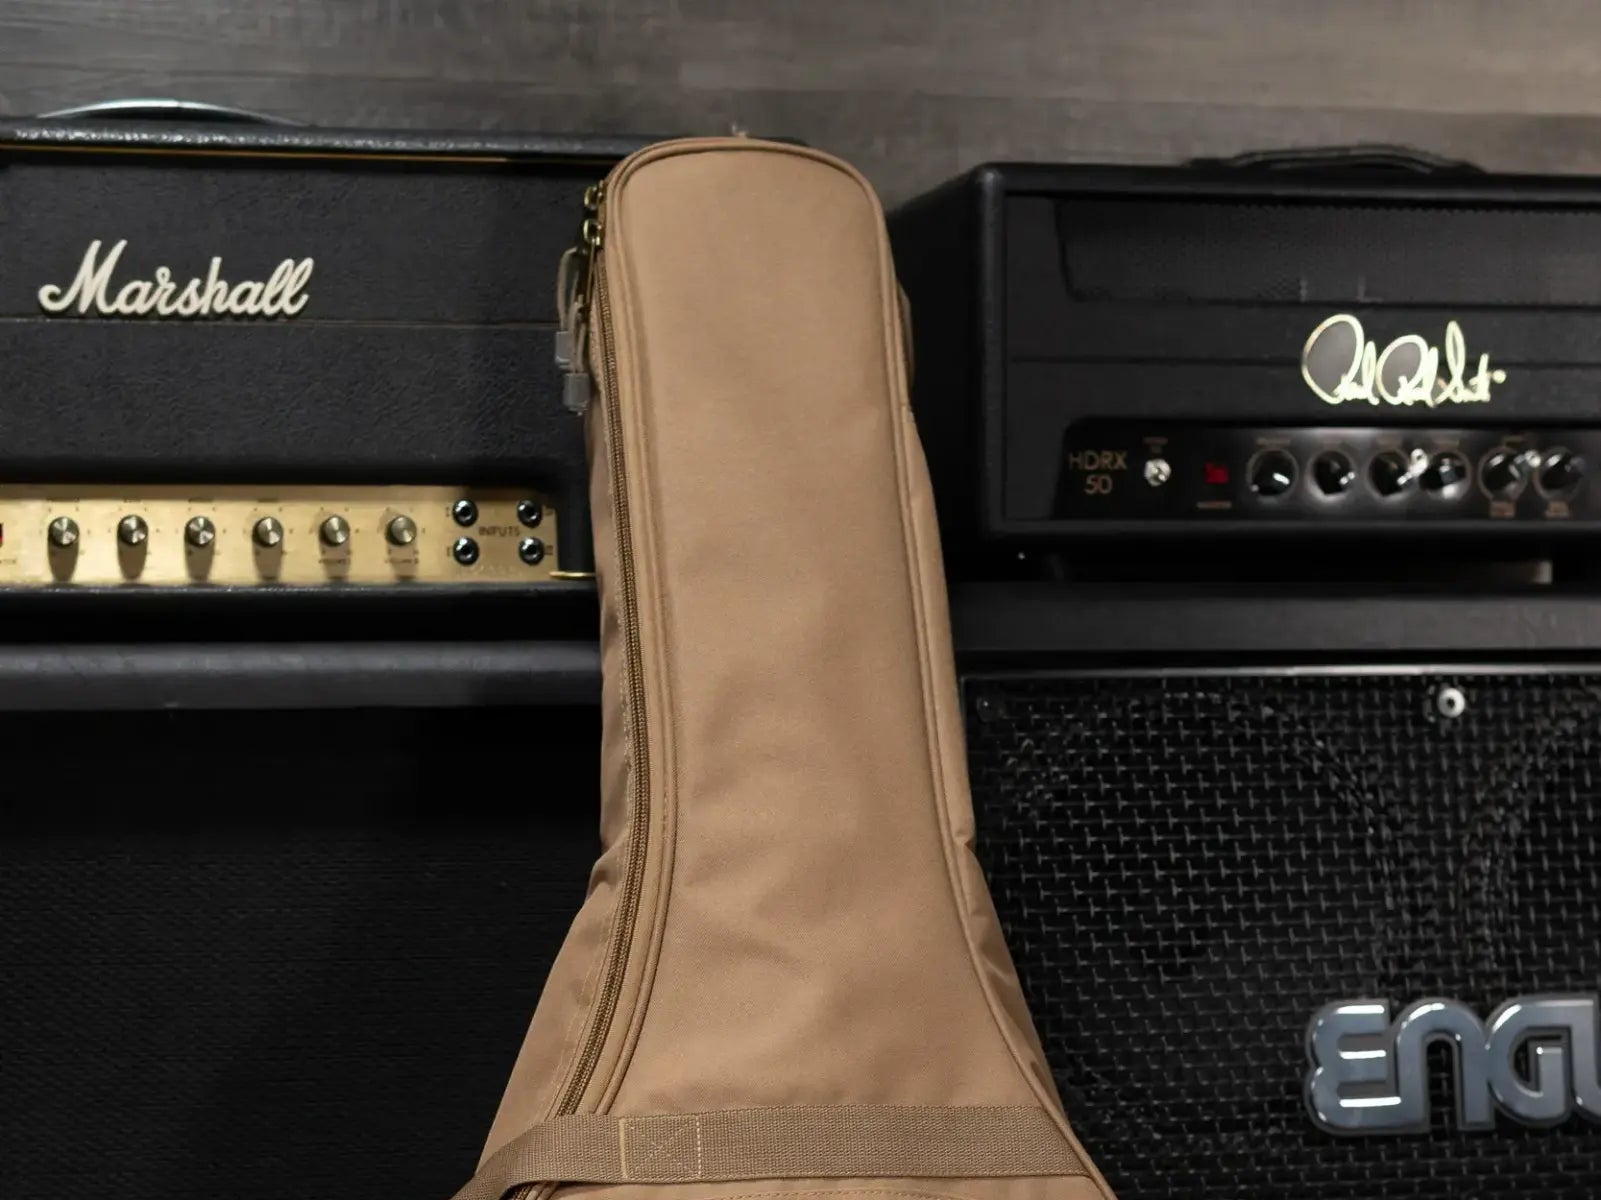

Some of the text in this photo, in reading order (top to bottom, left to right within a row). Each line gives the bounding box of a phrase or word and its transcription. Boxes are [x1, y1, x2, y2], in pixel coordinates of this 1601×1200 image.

[37, 239, 314, 316] Marshall
[1068, 451, 1128, 471] HDRX
[1084, 474, 1113, 495] 50
[477, 525, 521, 538] INPUTS
